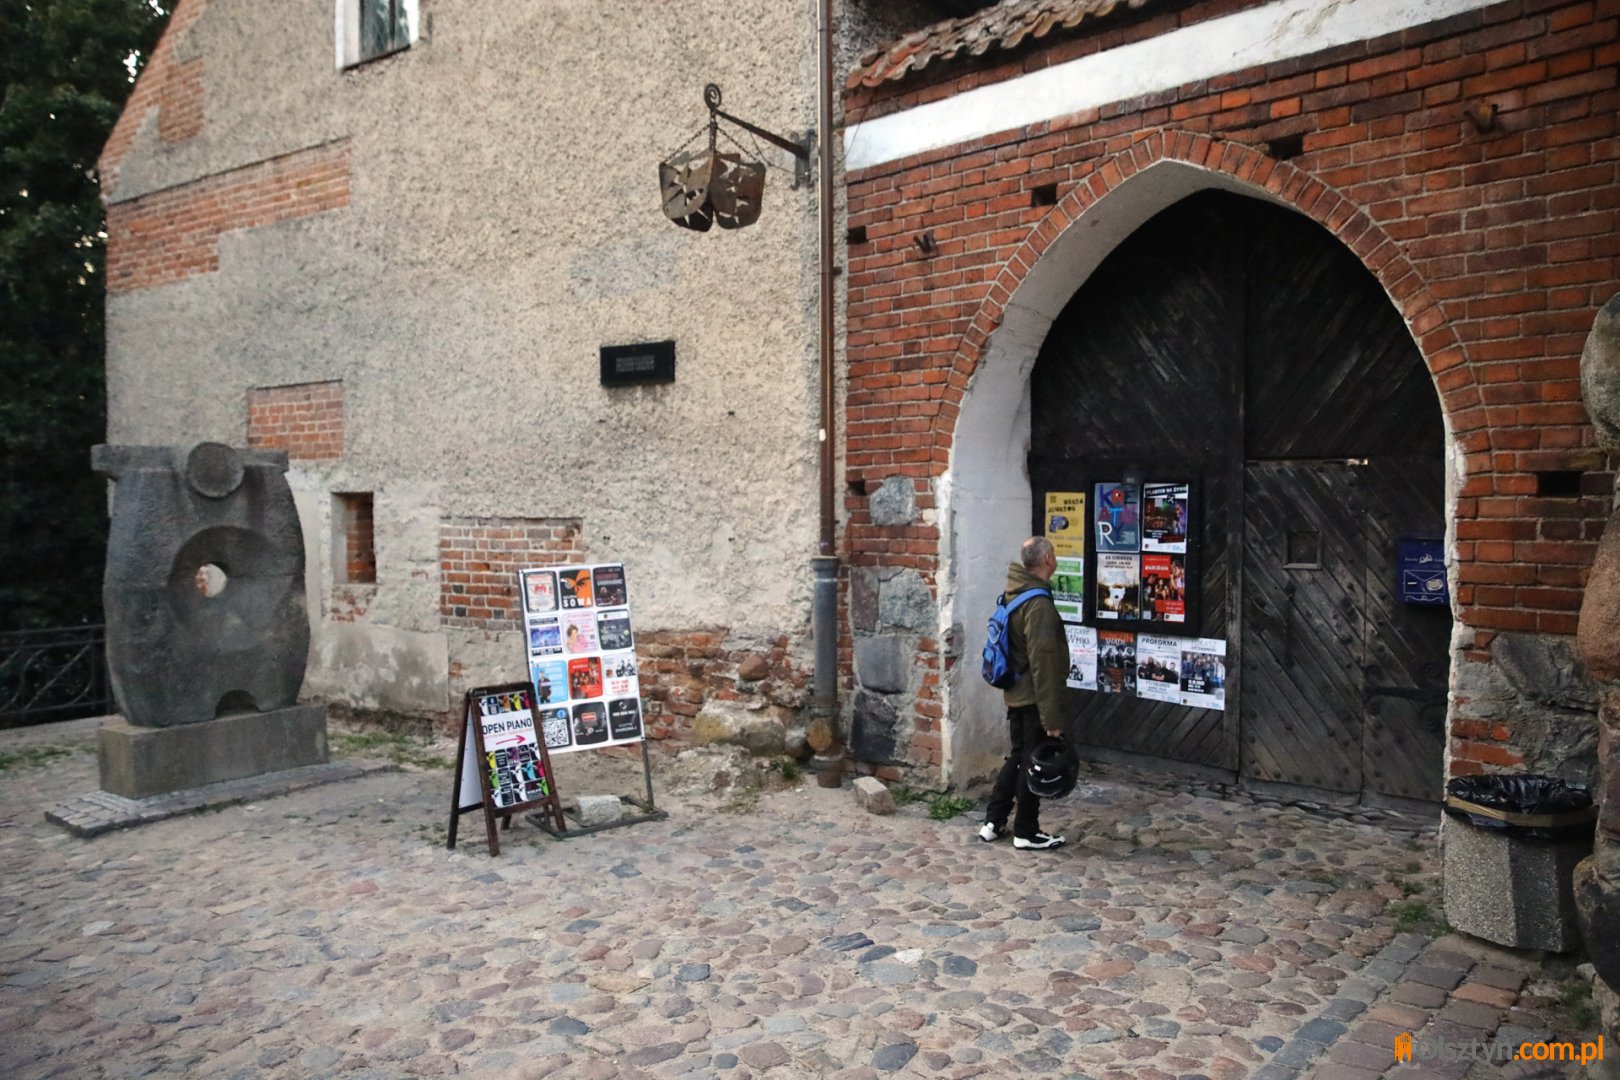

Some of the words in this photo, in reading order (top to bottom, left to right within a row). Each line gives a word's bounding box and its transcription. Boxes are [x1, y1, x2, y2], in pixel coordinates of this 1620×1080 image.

[563, 597, 592, 608] SOWA
[1141, 637, 1177, 647] PROFORMA
[482, 721, 506, 735] OPEN
[506, 717, 533, 730] PIANO
